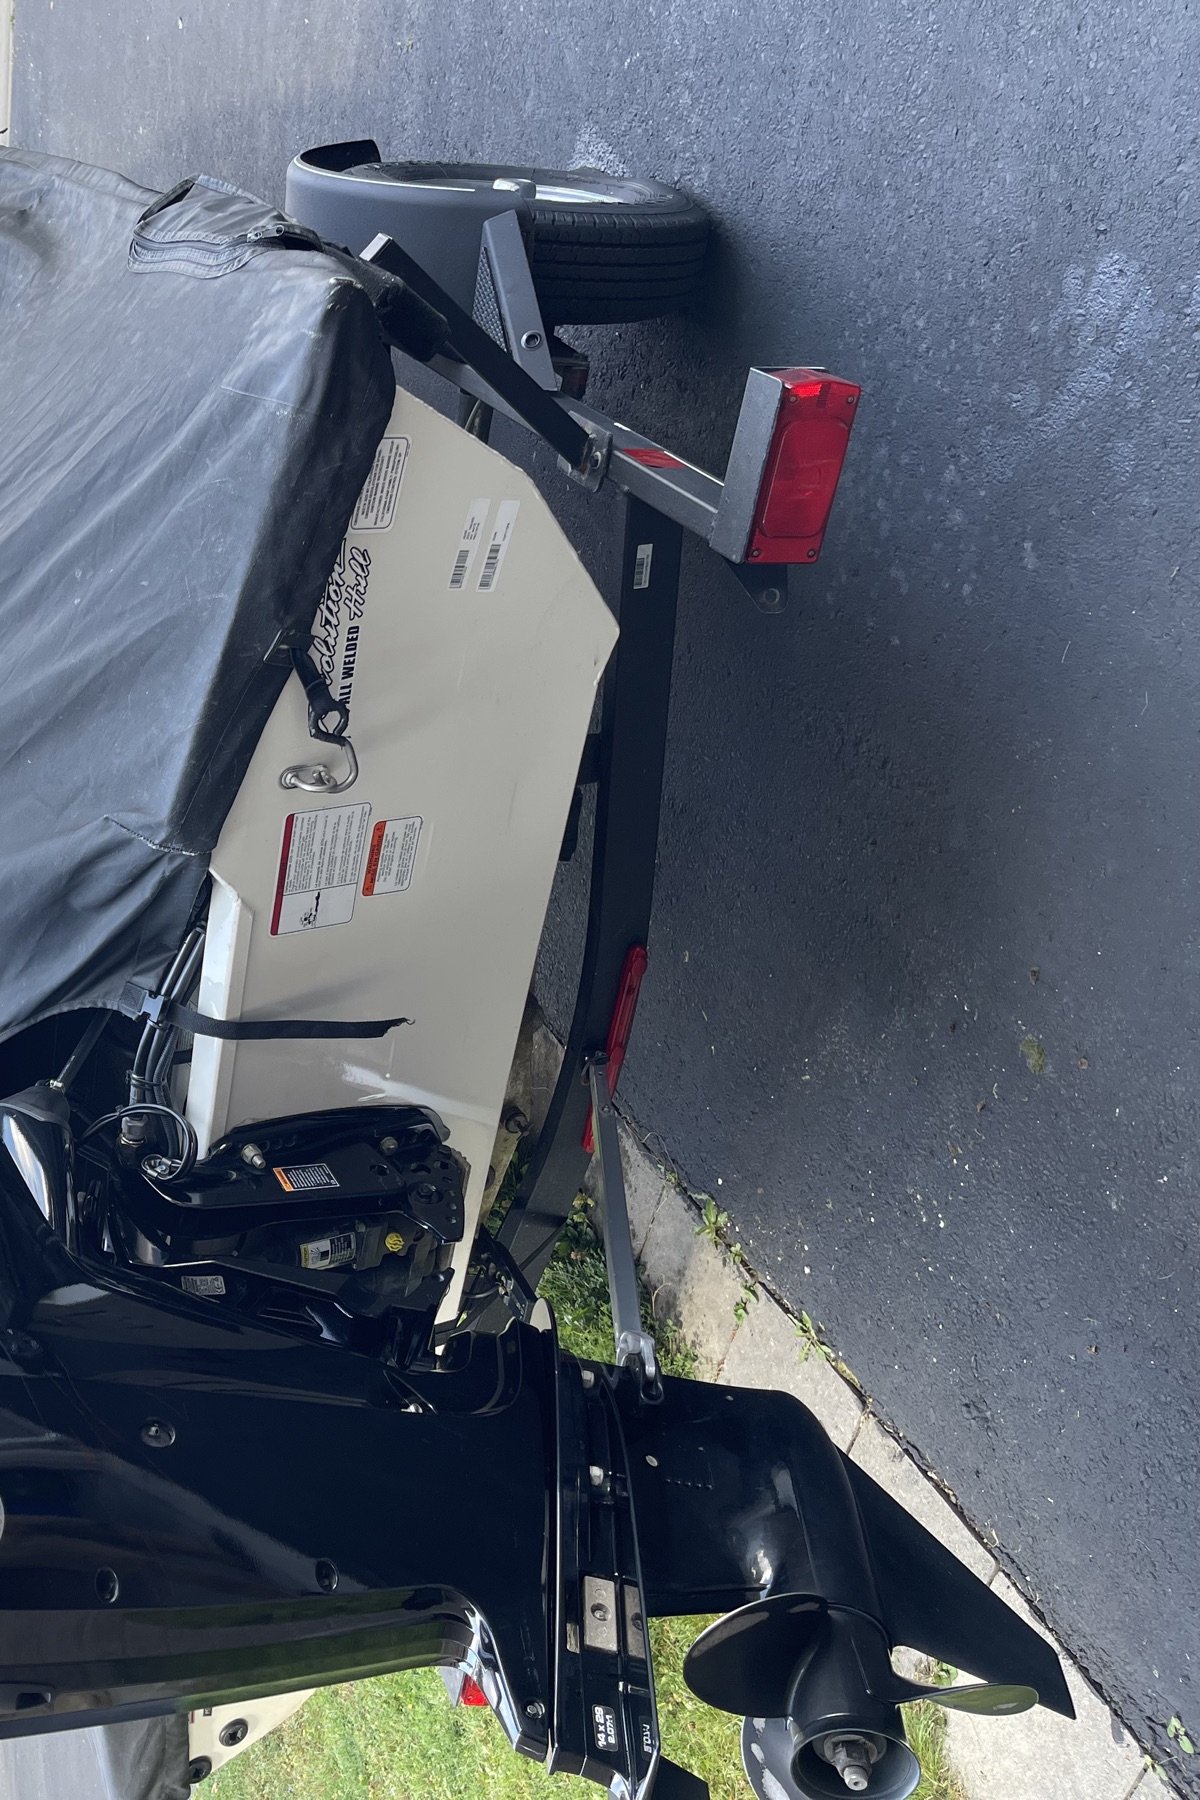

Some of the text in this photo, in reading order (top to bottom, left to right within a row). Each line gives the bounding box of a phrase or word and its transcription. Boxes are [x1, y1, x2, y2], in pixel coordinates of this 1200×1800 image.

[344, 545, 371, 621] Hull
[339, 625, 360, 705] ALL WELDED
[595, 1706, 604, 1724] 29
[606, 1714, 616, 1744] 2.07:1
[596, 1734, 607, 1748] 14
